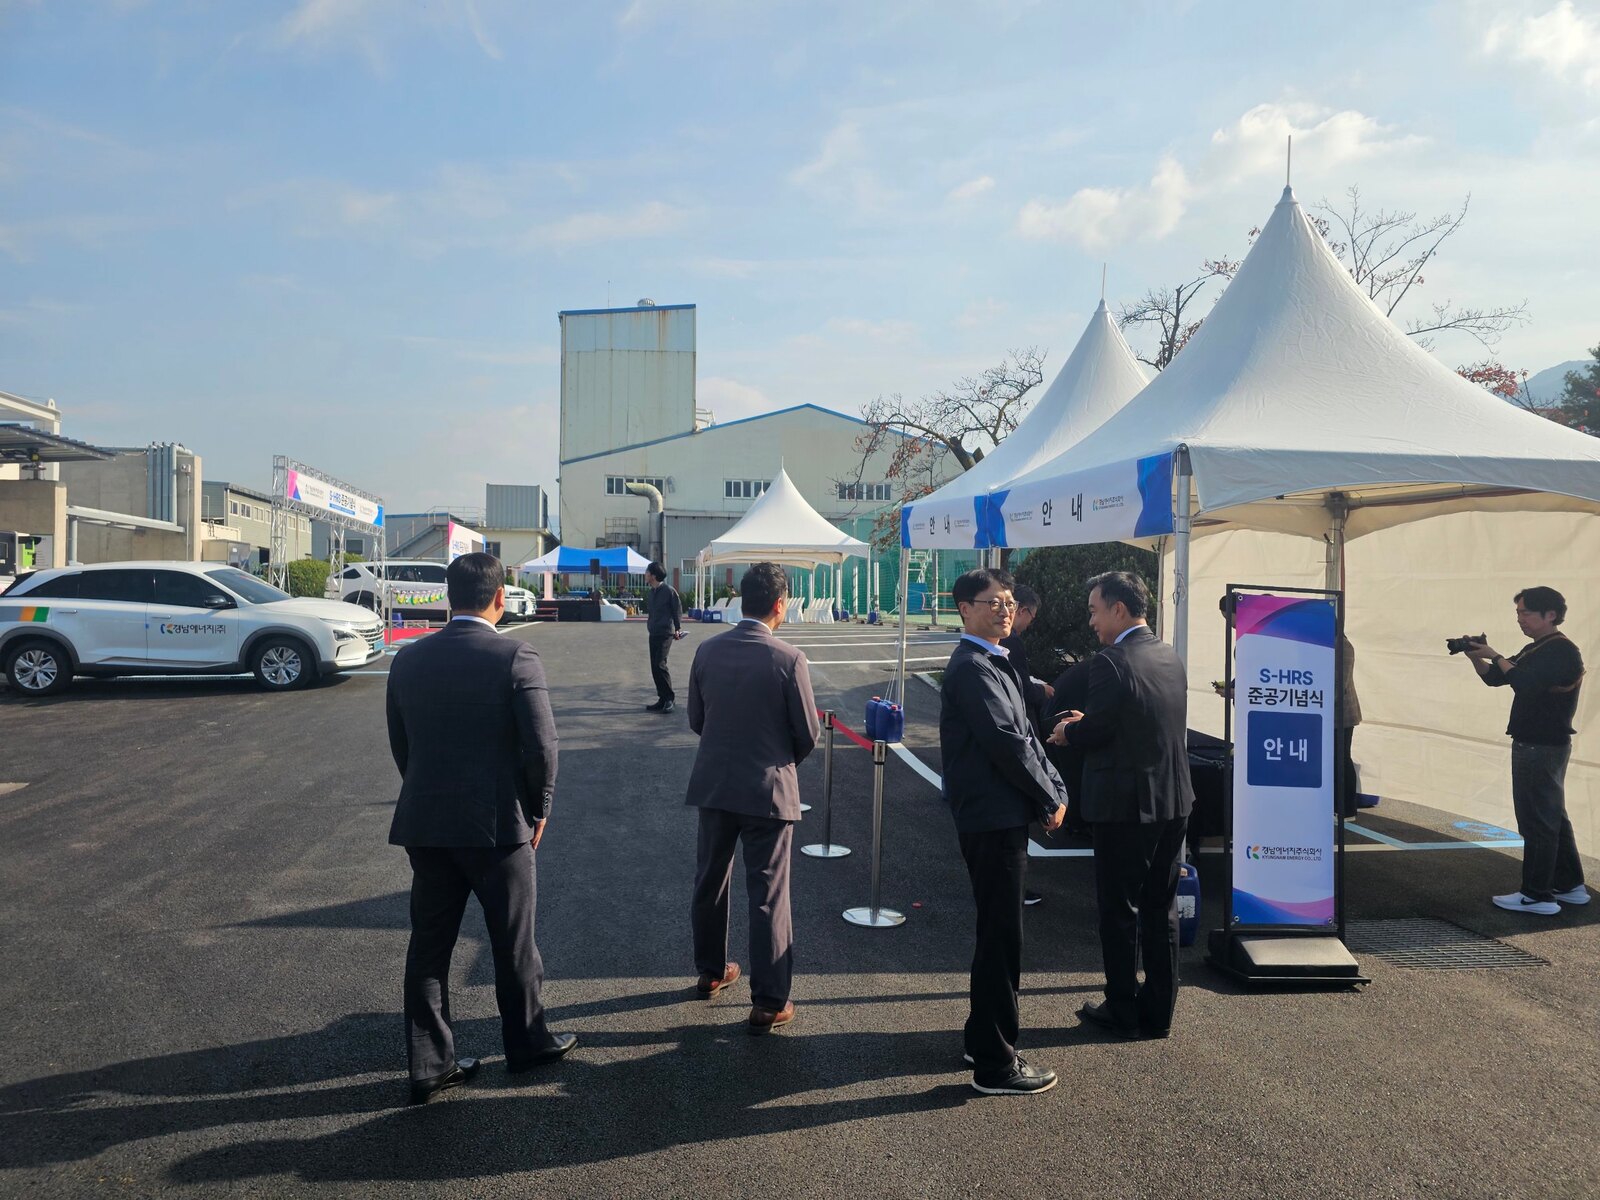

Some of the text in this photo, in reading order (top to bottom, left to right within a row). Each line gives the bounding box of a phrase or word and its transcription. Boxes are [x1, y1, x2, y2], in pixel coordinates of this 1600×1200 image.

[1259, 668, 1313, 685] S-HRS
[1248, 687, 1323, 708] 준공기념식
[1263, 737, 1308, 763] 안 내
[1262, 846, 1322, 856] 경남에너지주식회사
